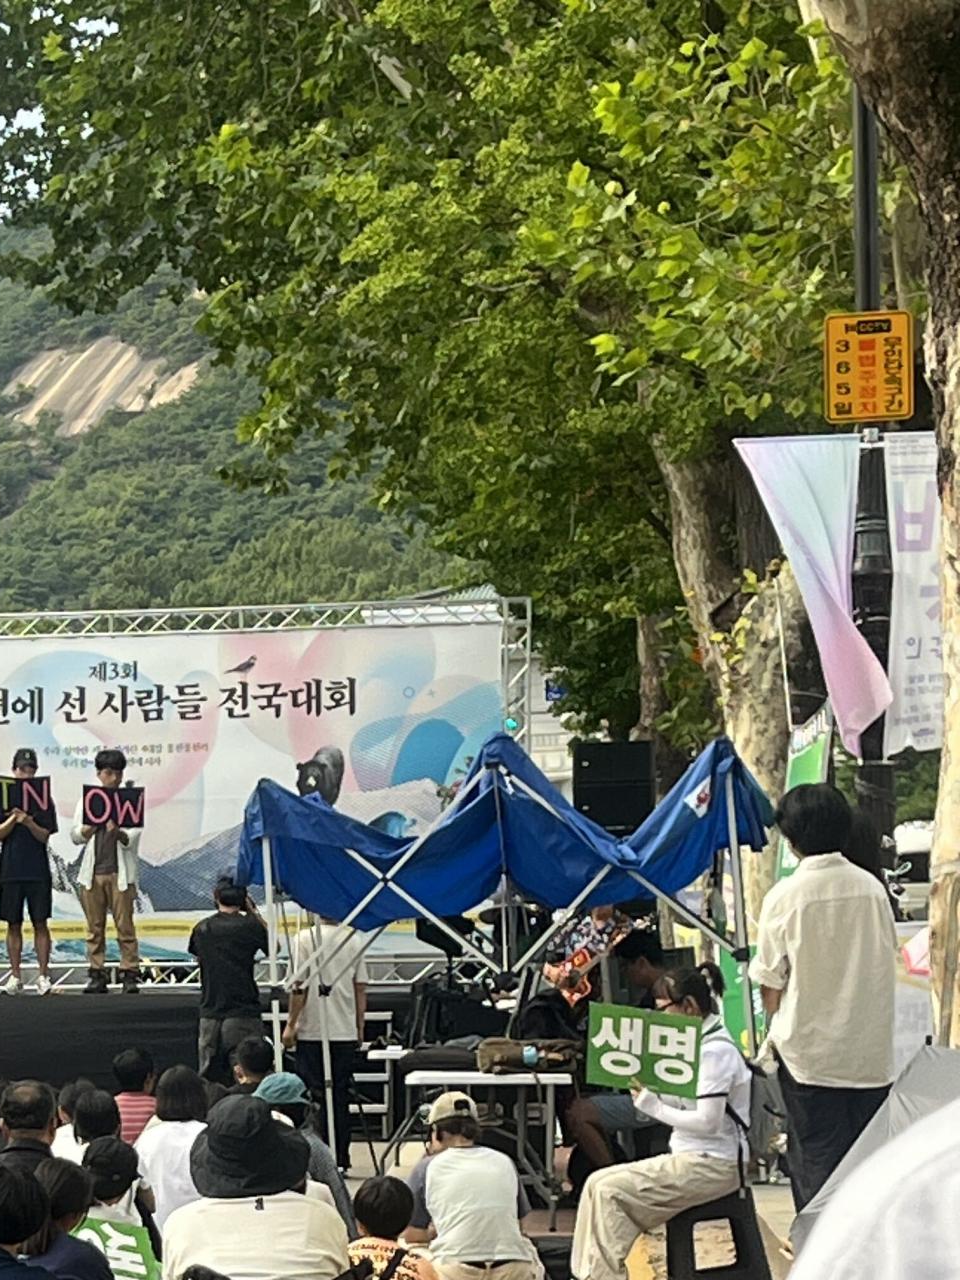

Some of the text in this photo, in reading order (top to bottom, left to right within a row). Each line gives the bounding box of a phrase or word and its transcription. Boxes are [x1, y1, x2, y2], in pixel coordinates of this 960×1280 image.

[88, 660, 138, 682] 제3회
[55, 685, 88, 723] 선
[98, 682, 208, 723] 사람들
[218, 676, 358, 719] 전국대회
[591, 1016, 697, 1085] 생명
